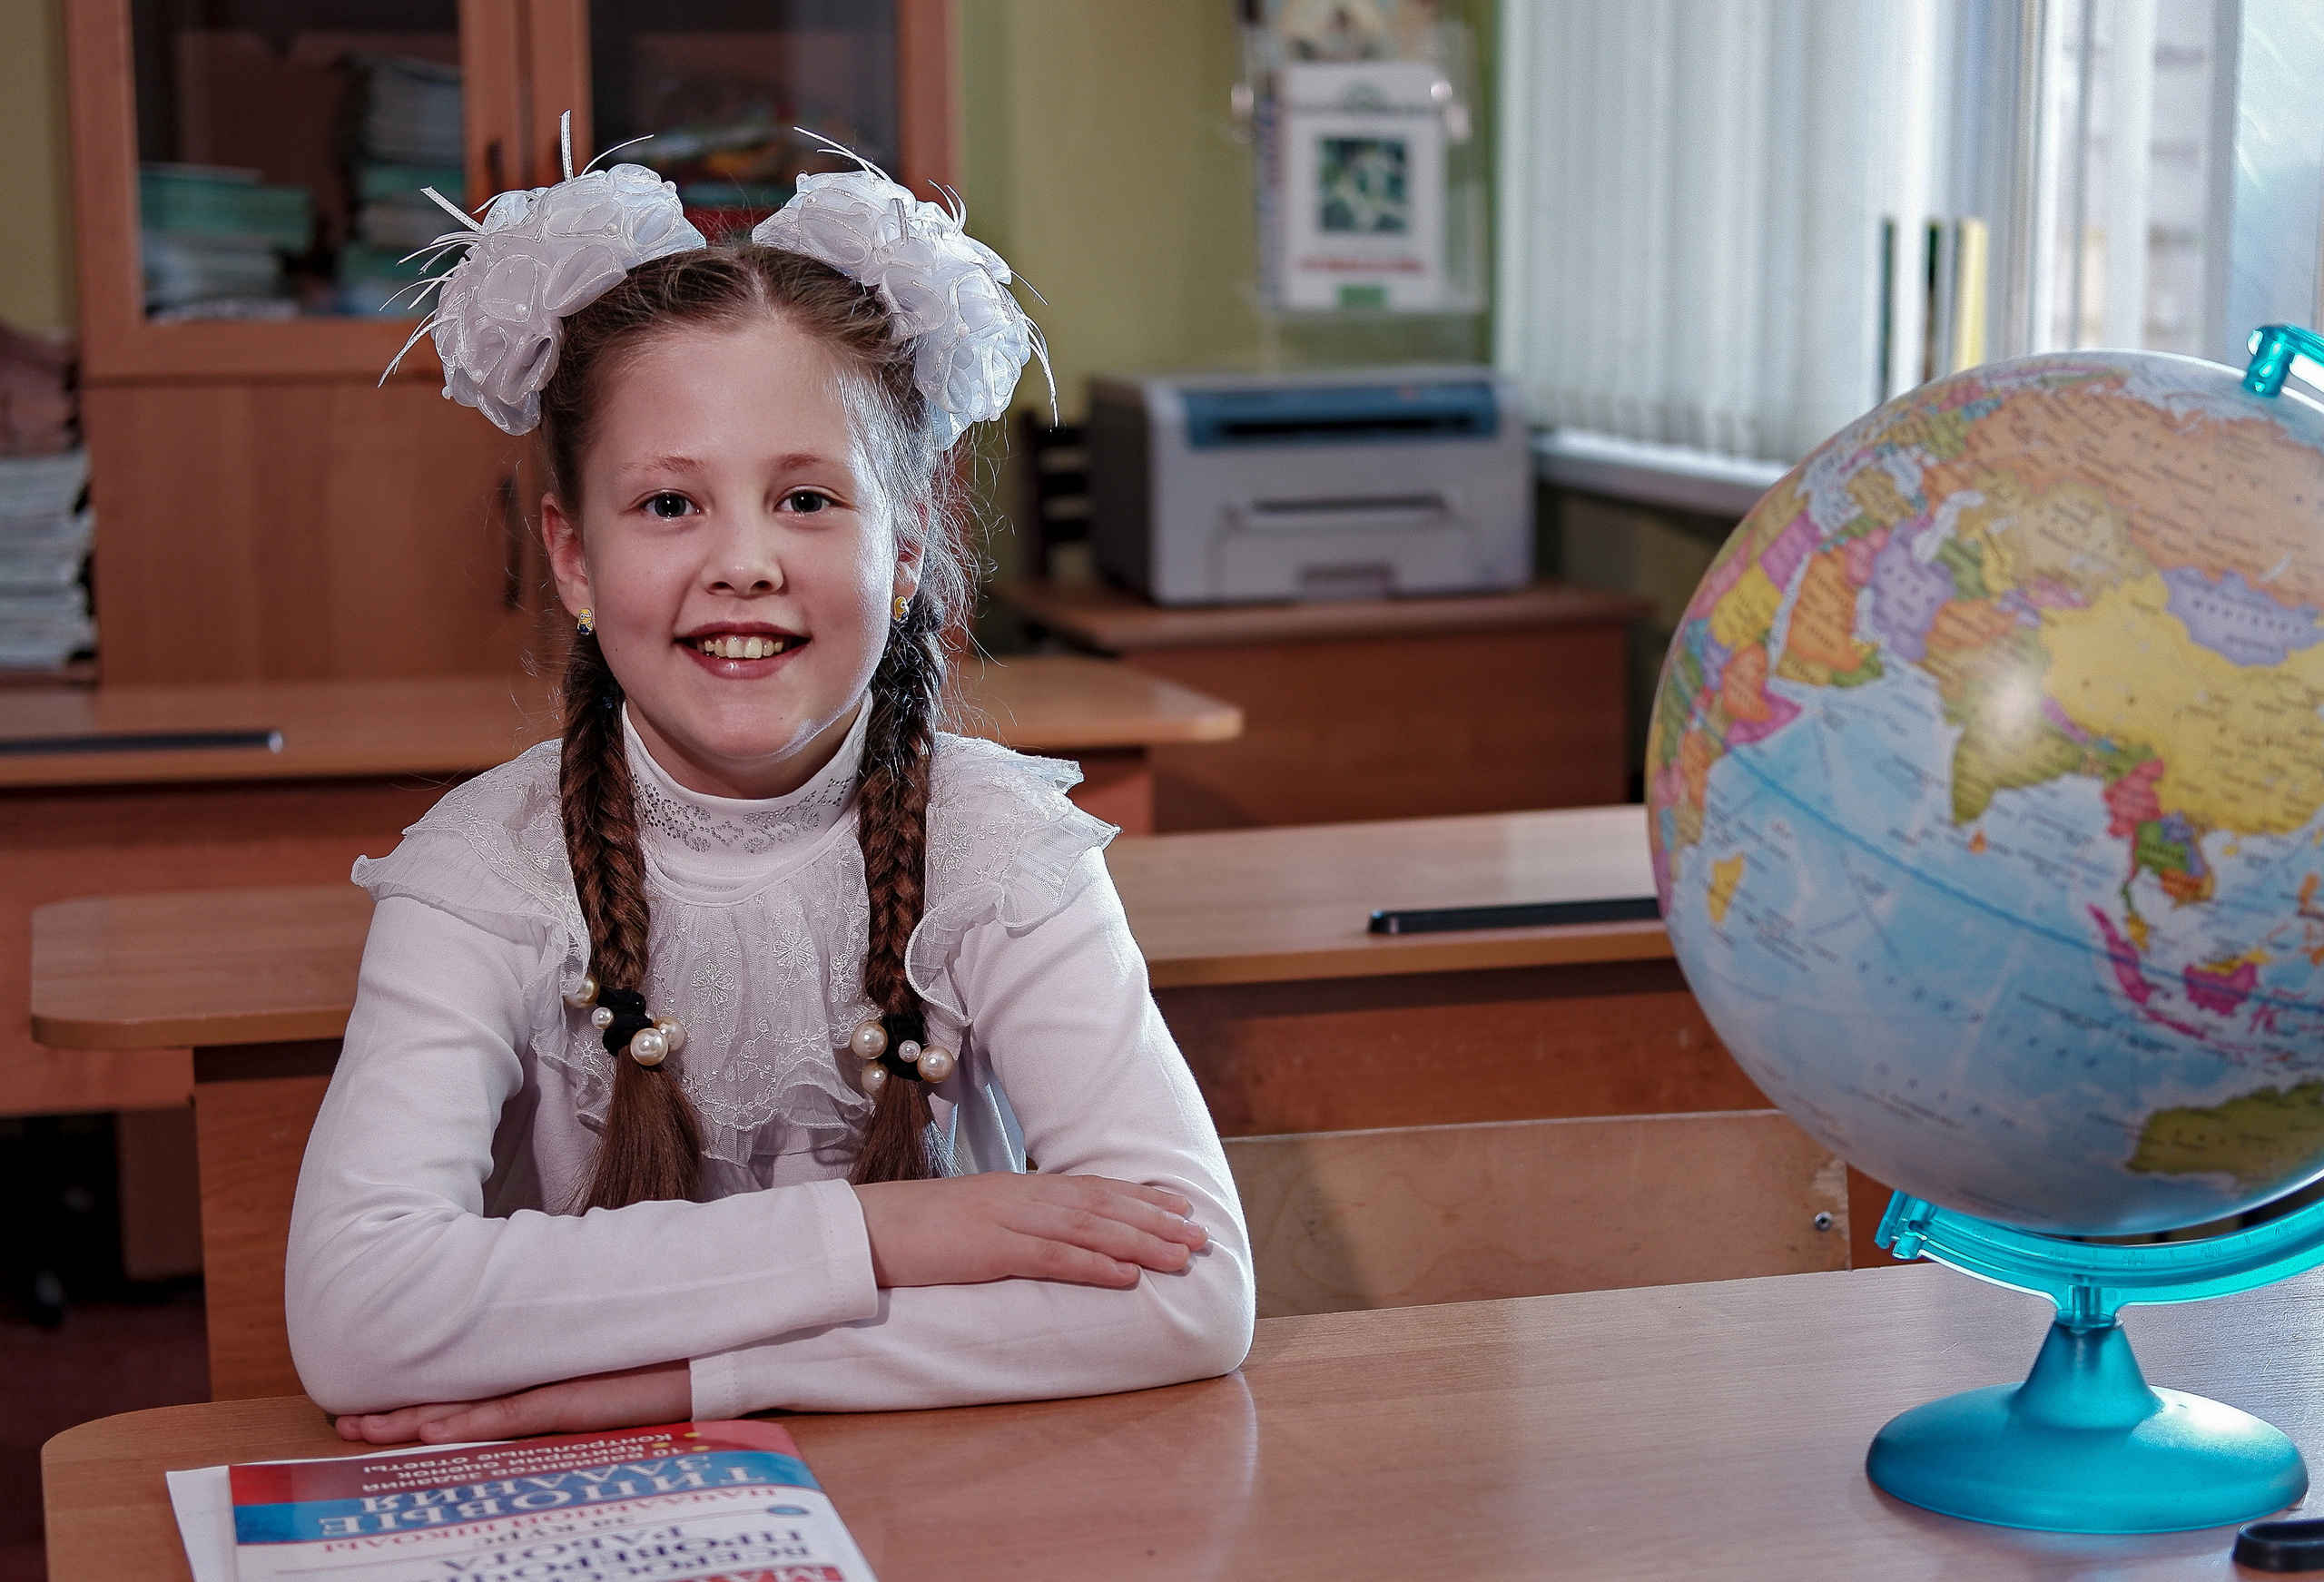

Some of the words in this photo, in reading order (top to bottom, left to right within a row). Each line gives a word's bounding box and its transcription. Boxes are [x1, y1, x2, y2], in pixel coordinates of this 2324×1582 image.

[477, 1433, 673, 1461] Контрольные
[508, 1445, 645, 1466] Критерии
[653, 1448, 683, 1458] 10
[363, 1456, 468, 1474] ответы
[397, 1461, 499, 1479] оценок
[491, 1452, 644, 1476] вариантов
[360, 1456, 712, 1513] ЗАДАНИЯ
[362, 1472, 482, 1492] заданий
[319, 1467, 766, 1536] ТИПОВЫЕ
[327, 1525, 494, 1553] ШКОЛЫ
[439, 1527, 683, 1572] РАБОТА
[422, 1531, 803, 1582] ПРОВЕРОЧ
